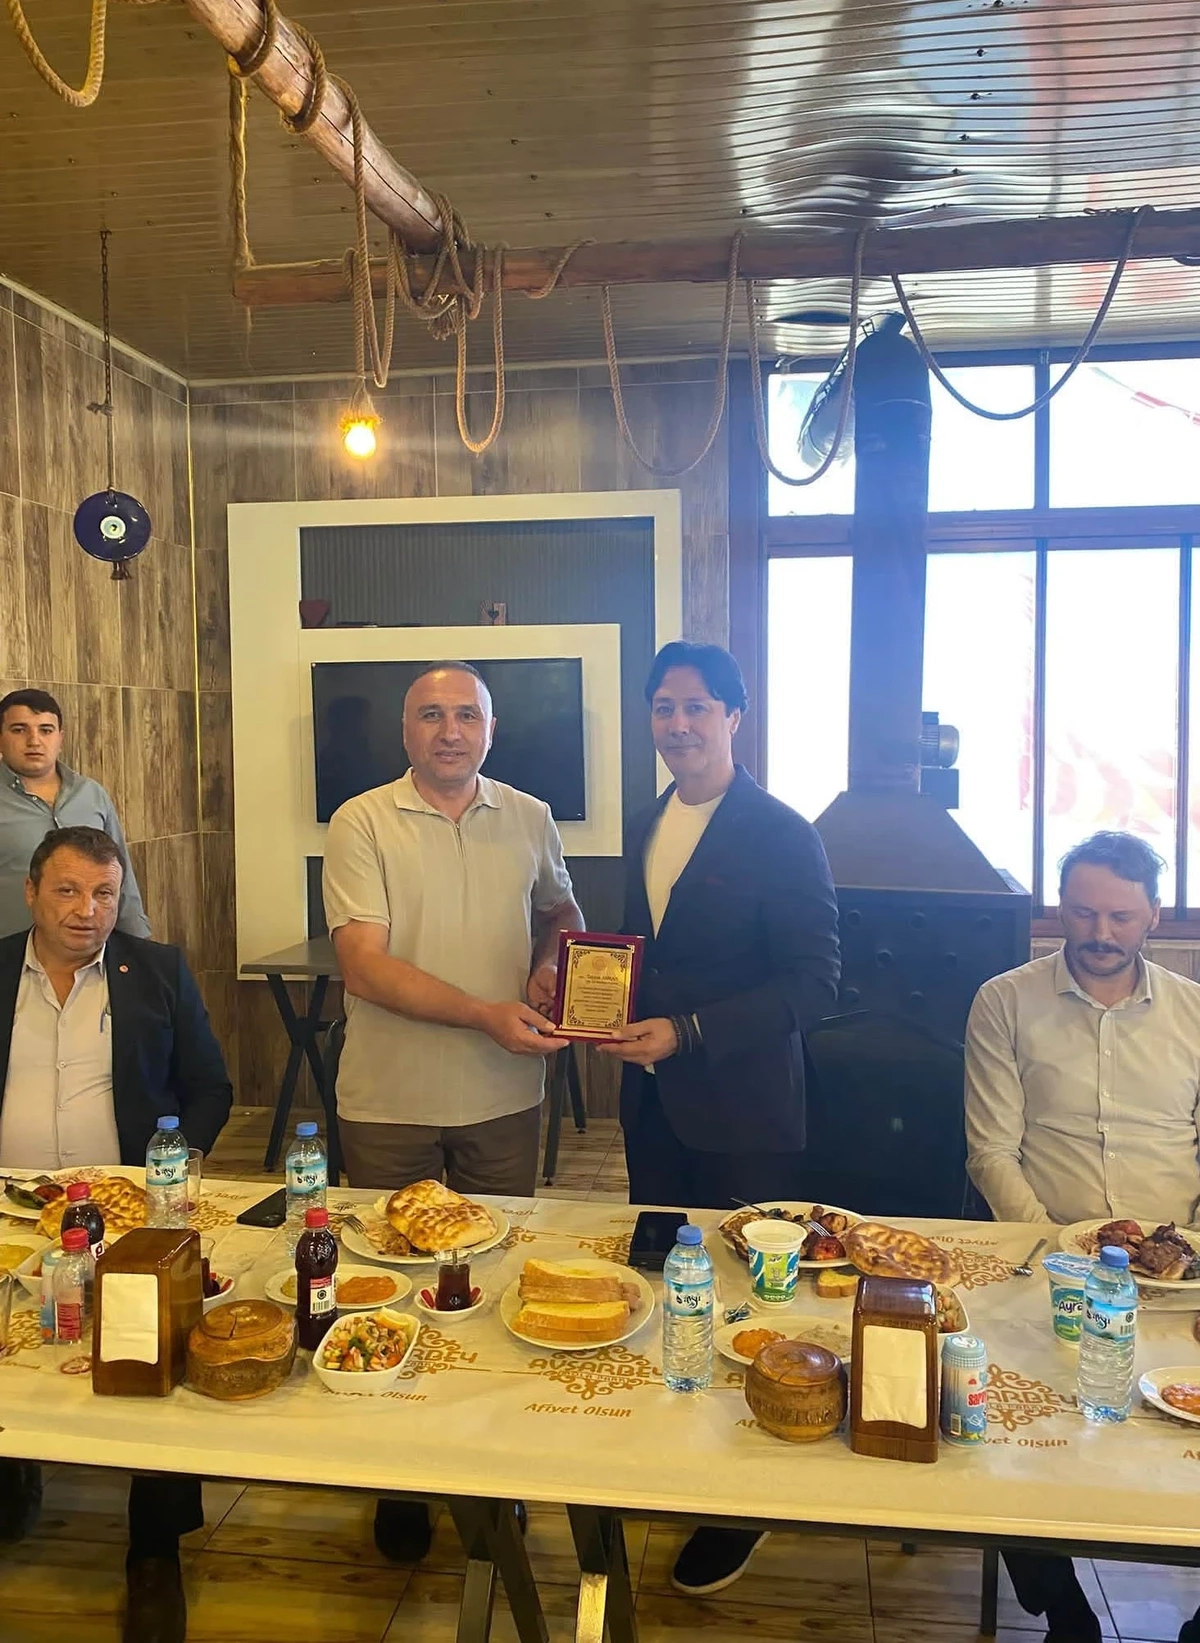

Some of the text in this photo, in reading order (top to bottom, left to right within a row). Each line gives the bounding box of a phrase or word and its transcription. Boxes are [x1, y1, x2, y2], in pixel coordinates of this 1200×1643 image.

[1058, 1300, 1083, 1313] Ayra
[524, 1403, 632, 1418] Afiyet Olsun
[983, 1436, 1069, 1448] yet Olsun
